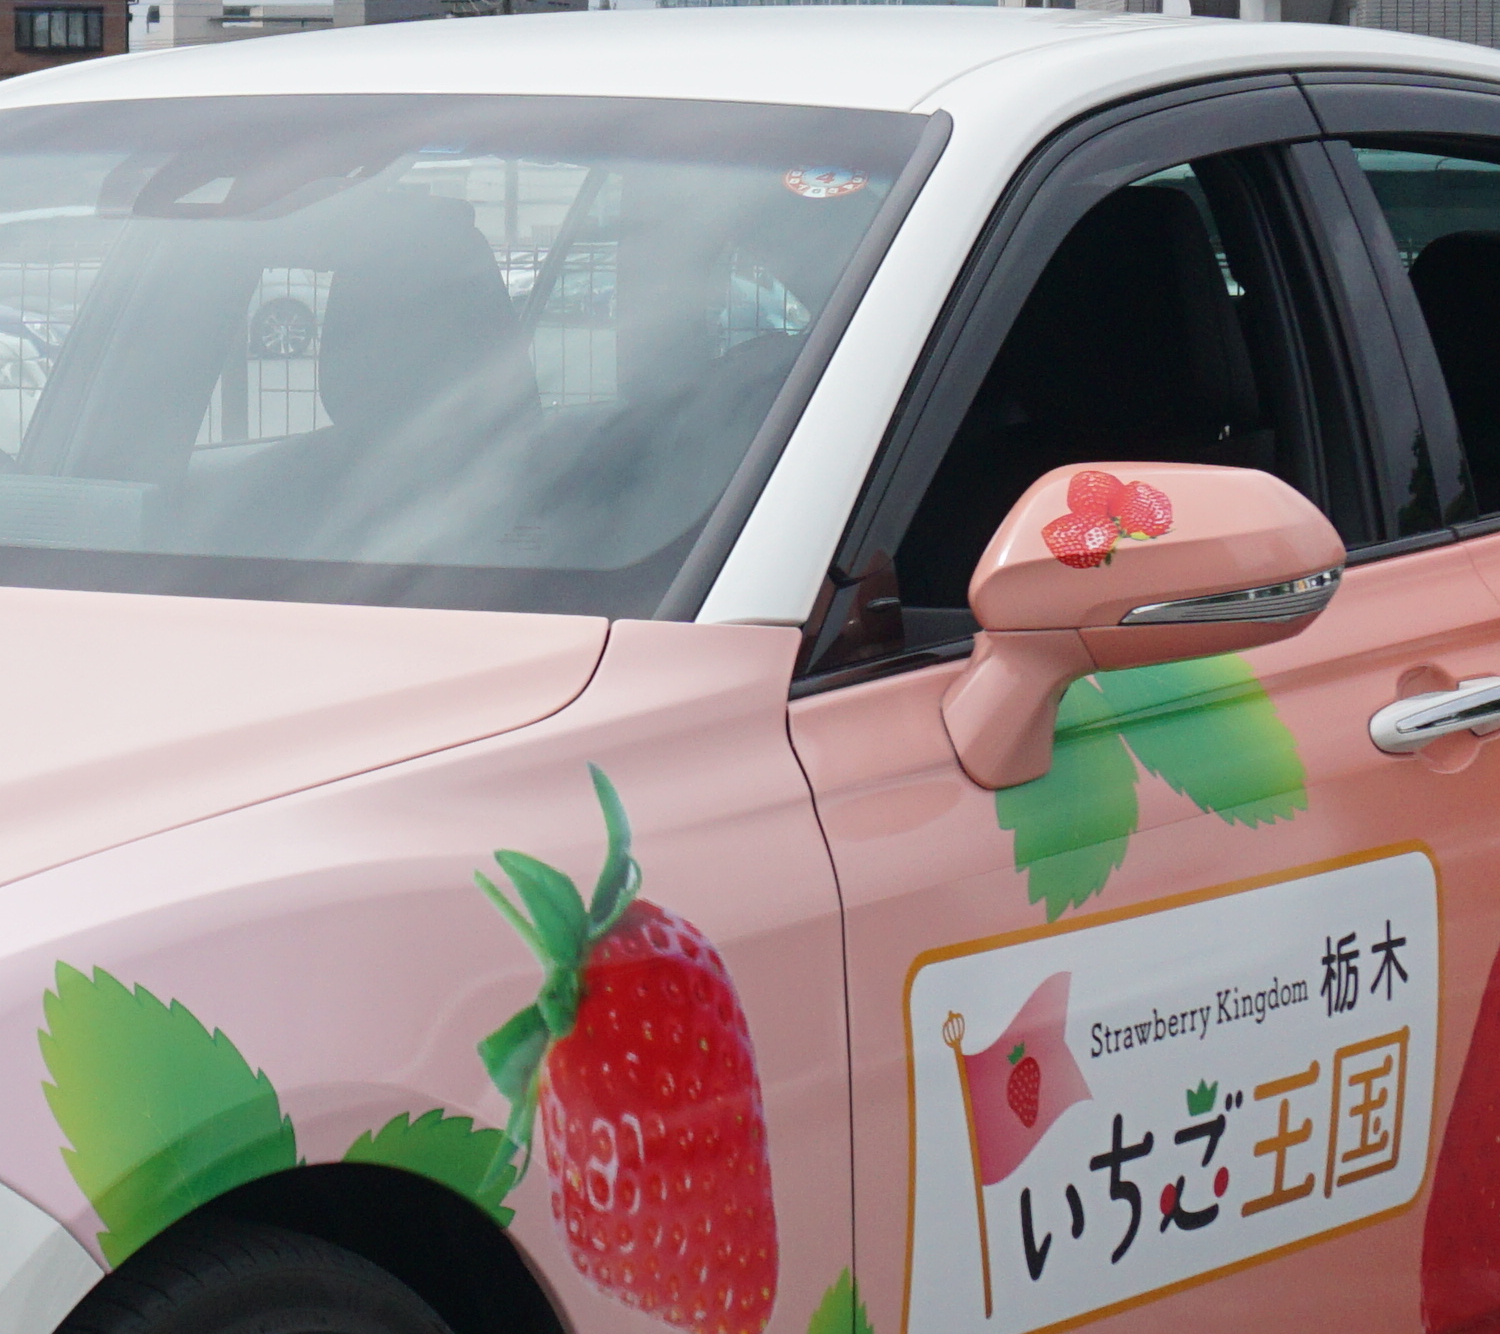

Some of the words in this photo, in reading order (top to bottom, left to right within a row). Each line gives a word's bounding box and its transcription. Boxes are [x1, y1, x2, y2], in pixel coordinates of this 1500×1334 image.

[1090, 1001, 1211, 1059] Strawberry
[1216, 977, 1309, 1025] Kingdom
[1320, 920, 1409, 1017] 栃木
[1020, 1025, 1411, 1281] いちご王国
